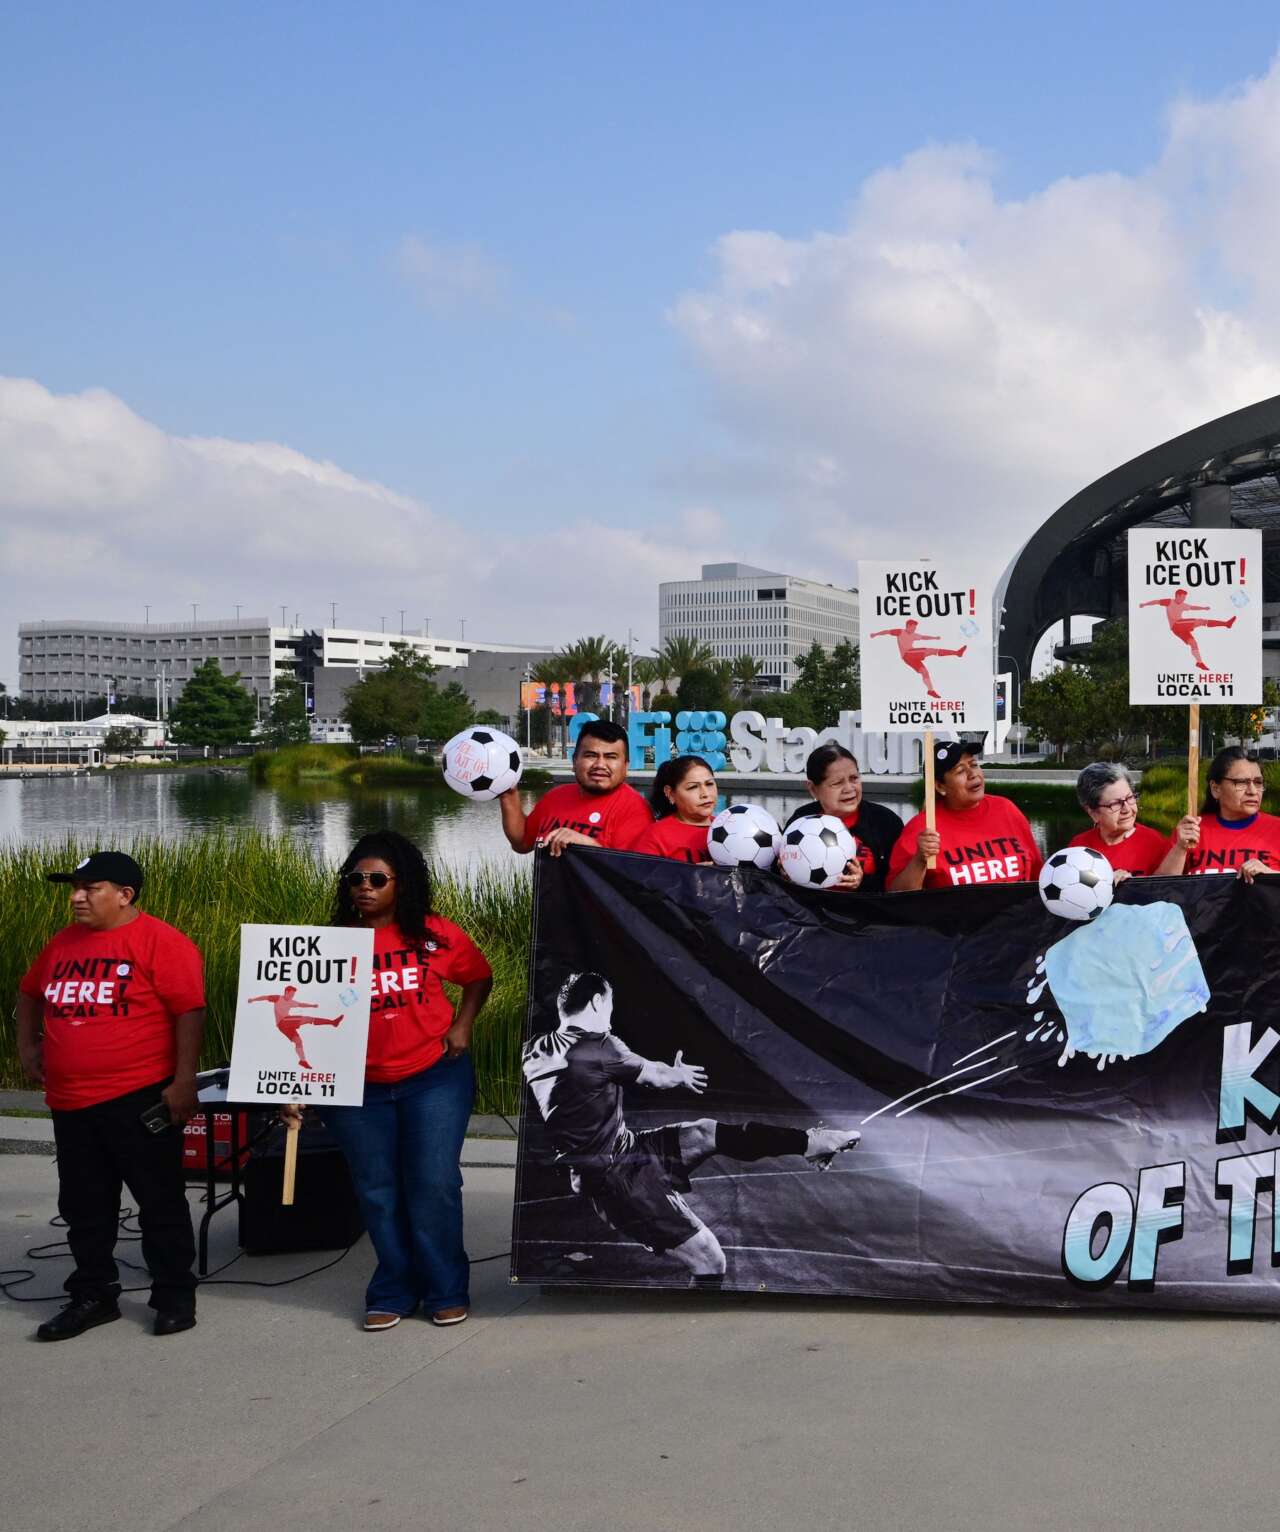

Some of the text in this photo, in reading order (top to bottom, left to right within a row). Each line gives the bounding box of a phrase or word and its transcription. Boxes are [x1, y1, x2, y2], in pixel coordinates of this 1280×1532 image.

[1156, 538, 1209, 562] KICK
[886, 570, 939, 593] KICK
[1146, 564, 1181, 586] ICE
[876, 595, 911, 616] ICE
[1157, 673, 1233, 683] UNITE HERE!
[1157, 684, 1234, 697] LOCAL 11
[889, 701, 965, 711] UNITE HERE!
[889, 712, 965, 724] LOCAL 11
[944, 838, 1024, 865] UNITE
[269, 935, 321, 958] KICK
[256, 960, 292, 982] ICE
[258, 1070, 336, 1083] UNITE HERE!
[256, 1081, 335, 1097] LOCAL 11
[1061, 1161, 1185, 1291] OF
